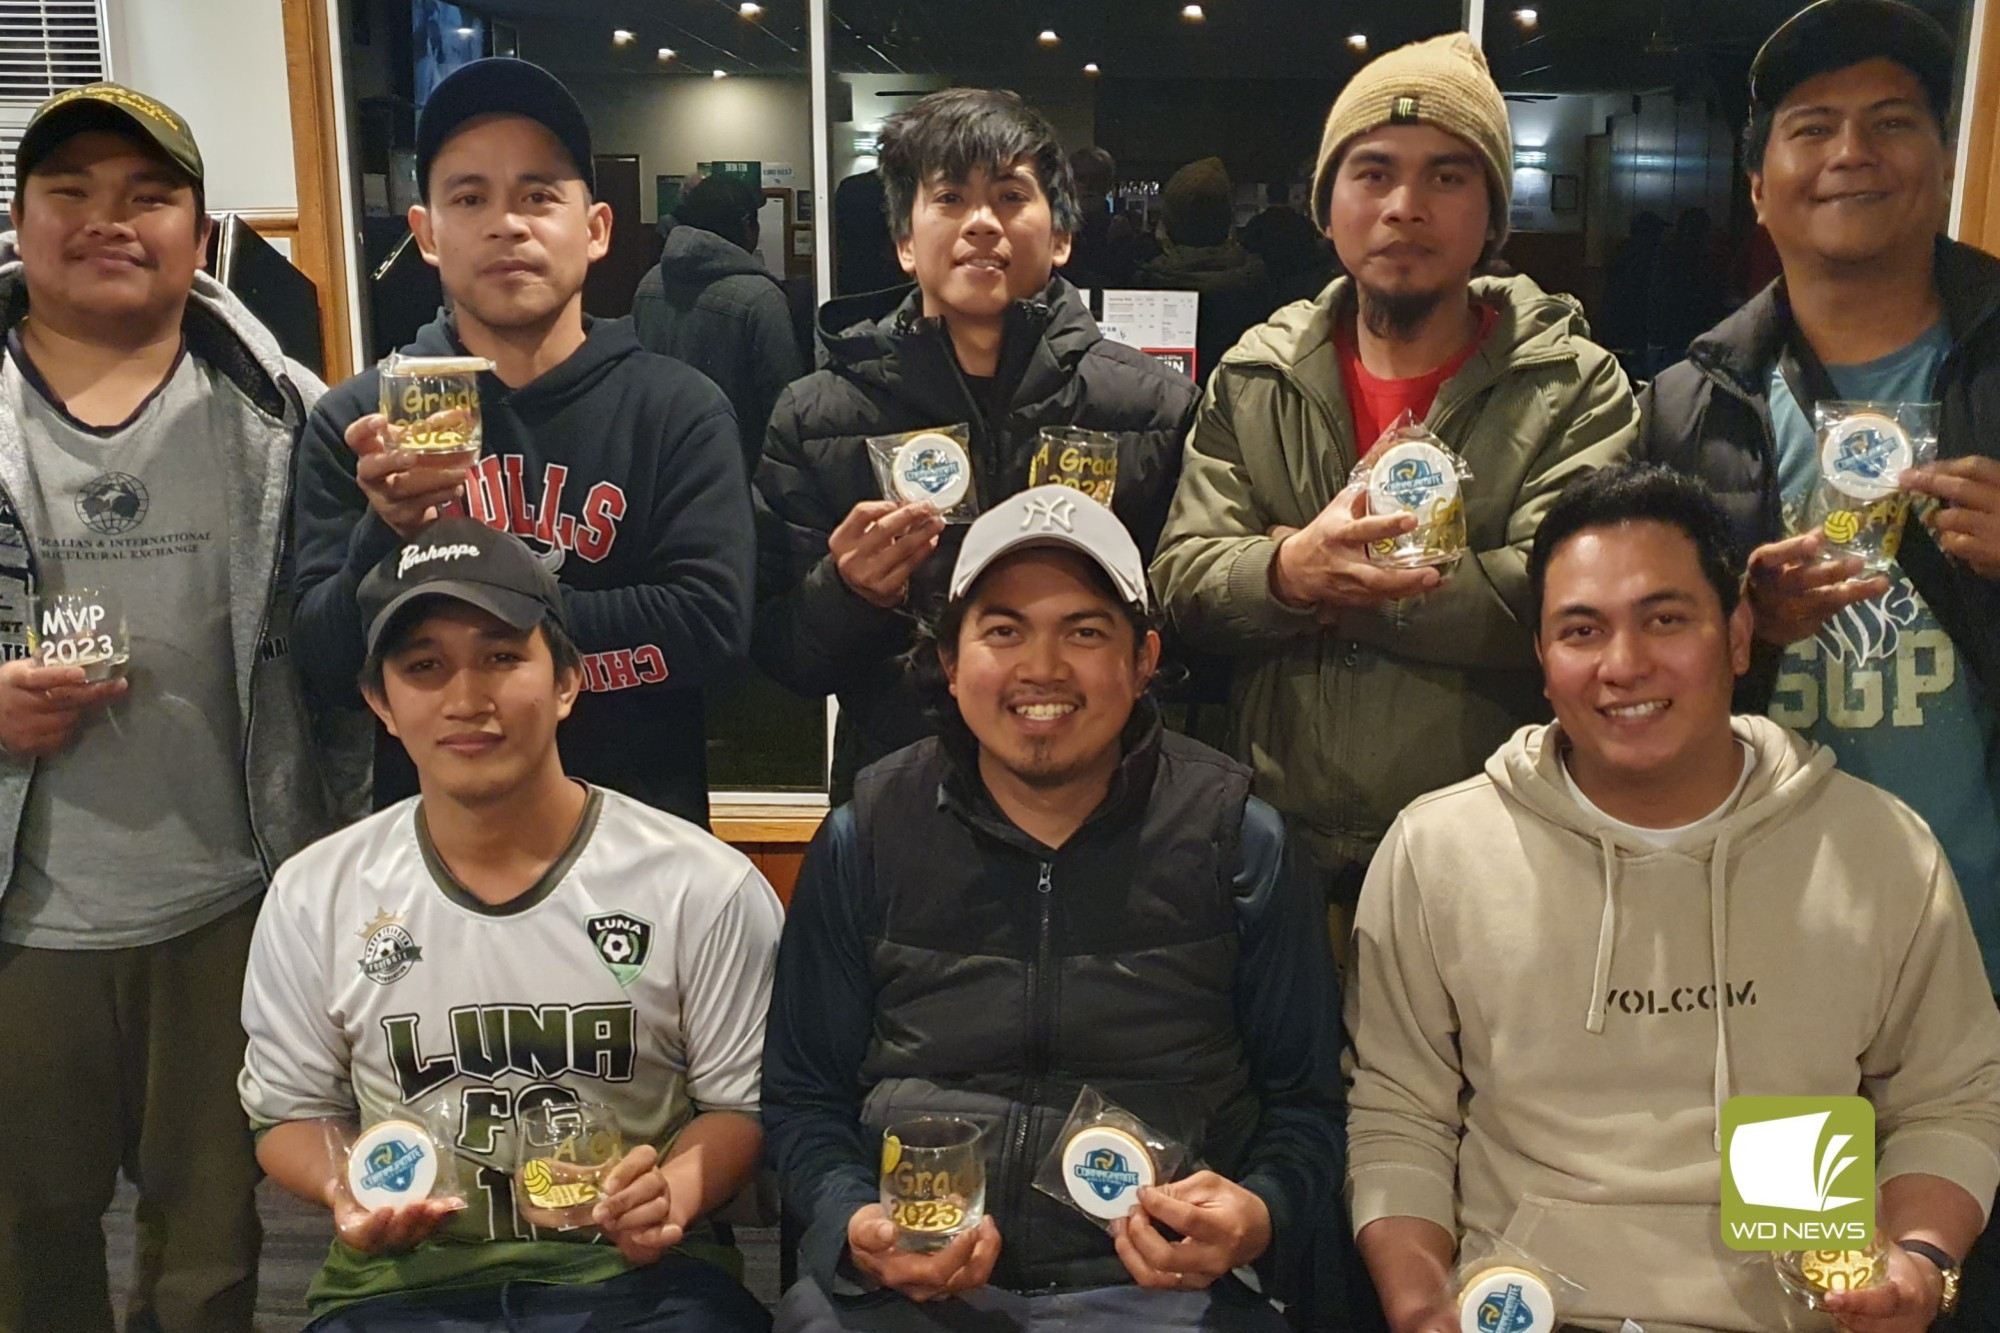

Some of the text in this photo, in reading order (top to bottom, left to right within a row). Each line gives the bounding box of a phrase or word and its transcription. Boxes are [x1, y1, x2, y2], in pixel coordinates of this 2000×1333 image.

[441, 454, 628, 564] ULLS
[42, 605, 105, 636] MVP
[41, 635, 114, 665] 2023
[577, 644, 669, 693] CHI
[1768, 629, 1956, 728] SGP
[594, 918, 642, 935] LUNA
[381, 1001, 638, 1105] LUNA
[1804, 1267, 1871, 1291] 202
